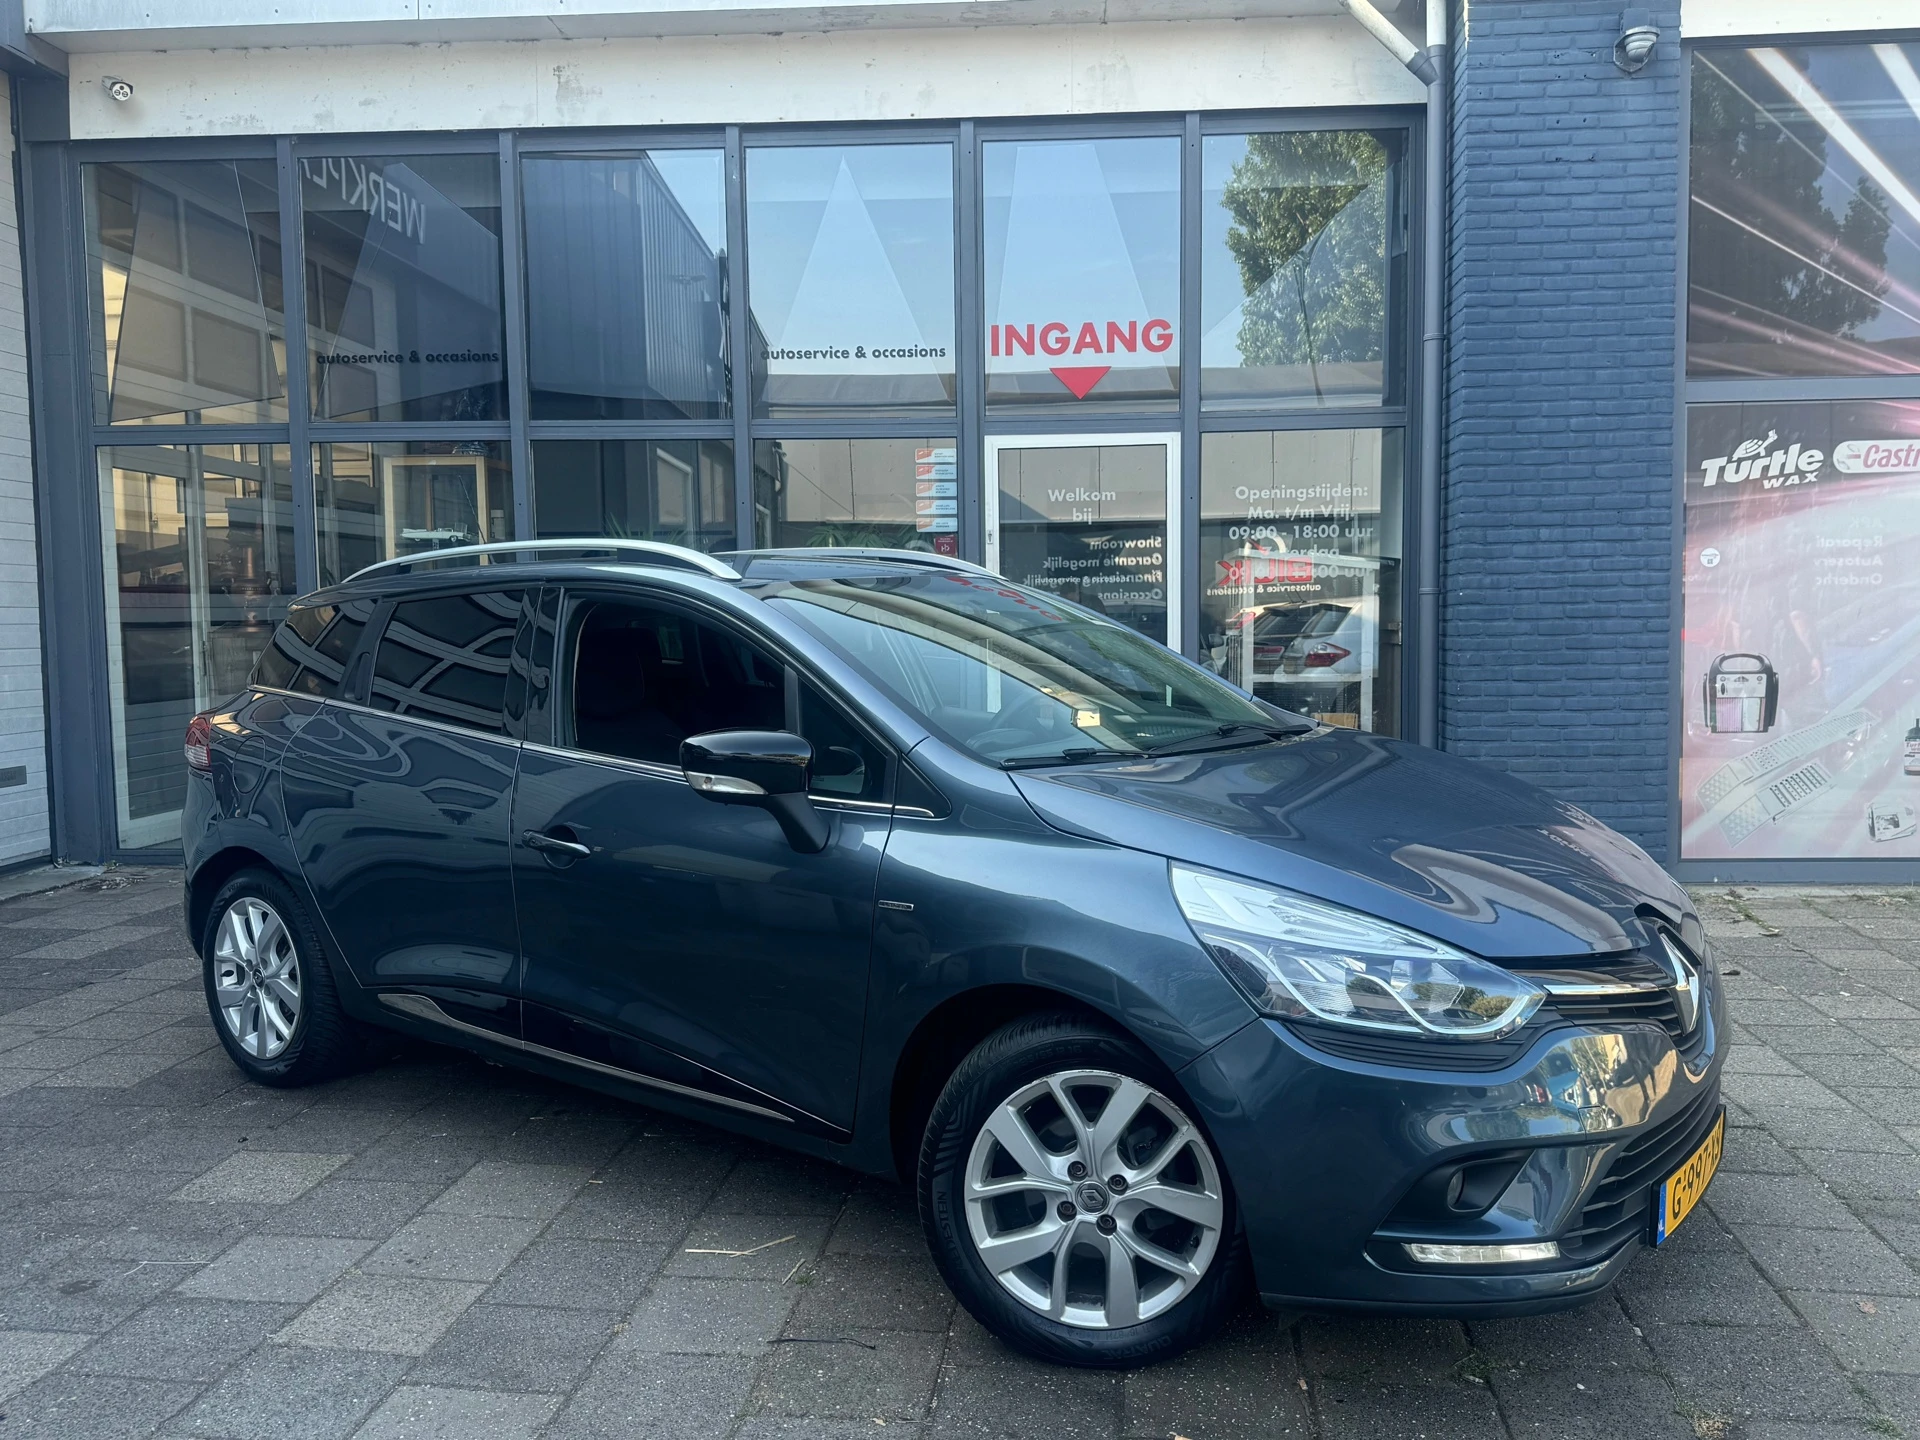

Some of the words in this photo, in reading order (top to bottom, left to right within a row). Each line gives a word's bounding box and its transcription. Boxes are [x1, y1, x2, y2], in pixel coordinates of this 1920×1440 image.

[990, 319, 1174, 357] INGANG
[316, 350, 404, 365] autoservice
[408, 350, 420, 364] &
[425, 349, 499, 364] occasions
[761, 345, 850, 361] autoservice
[854, 345, 867, 359] &
[871, 344, 946, 359] occasions
[1700, 443, 1824, 487] Turtle
[1762, 471, 1819, 489] WAX
[1048, 487, 1116, 502] Welkom
[1235, 483, 1368, 503] Openingstijden:
[1072, 508, 1093, 525] bij
[1247, 506, 1279, 519] Ma.
[1285, 504, 1314, 521] t/m
[1229, 526, 1277, 540] 09:00
[1293, 525, 1340, 539] 18:00
[1345, 527, 1373, 538] uur
